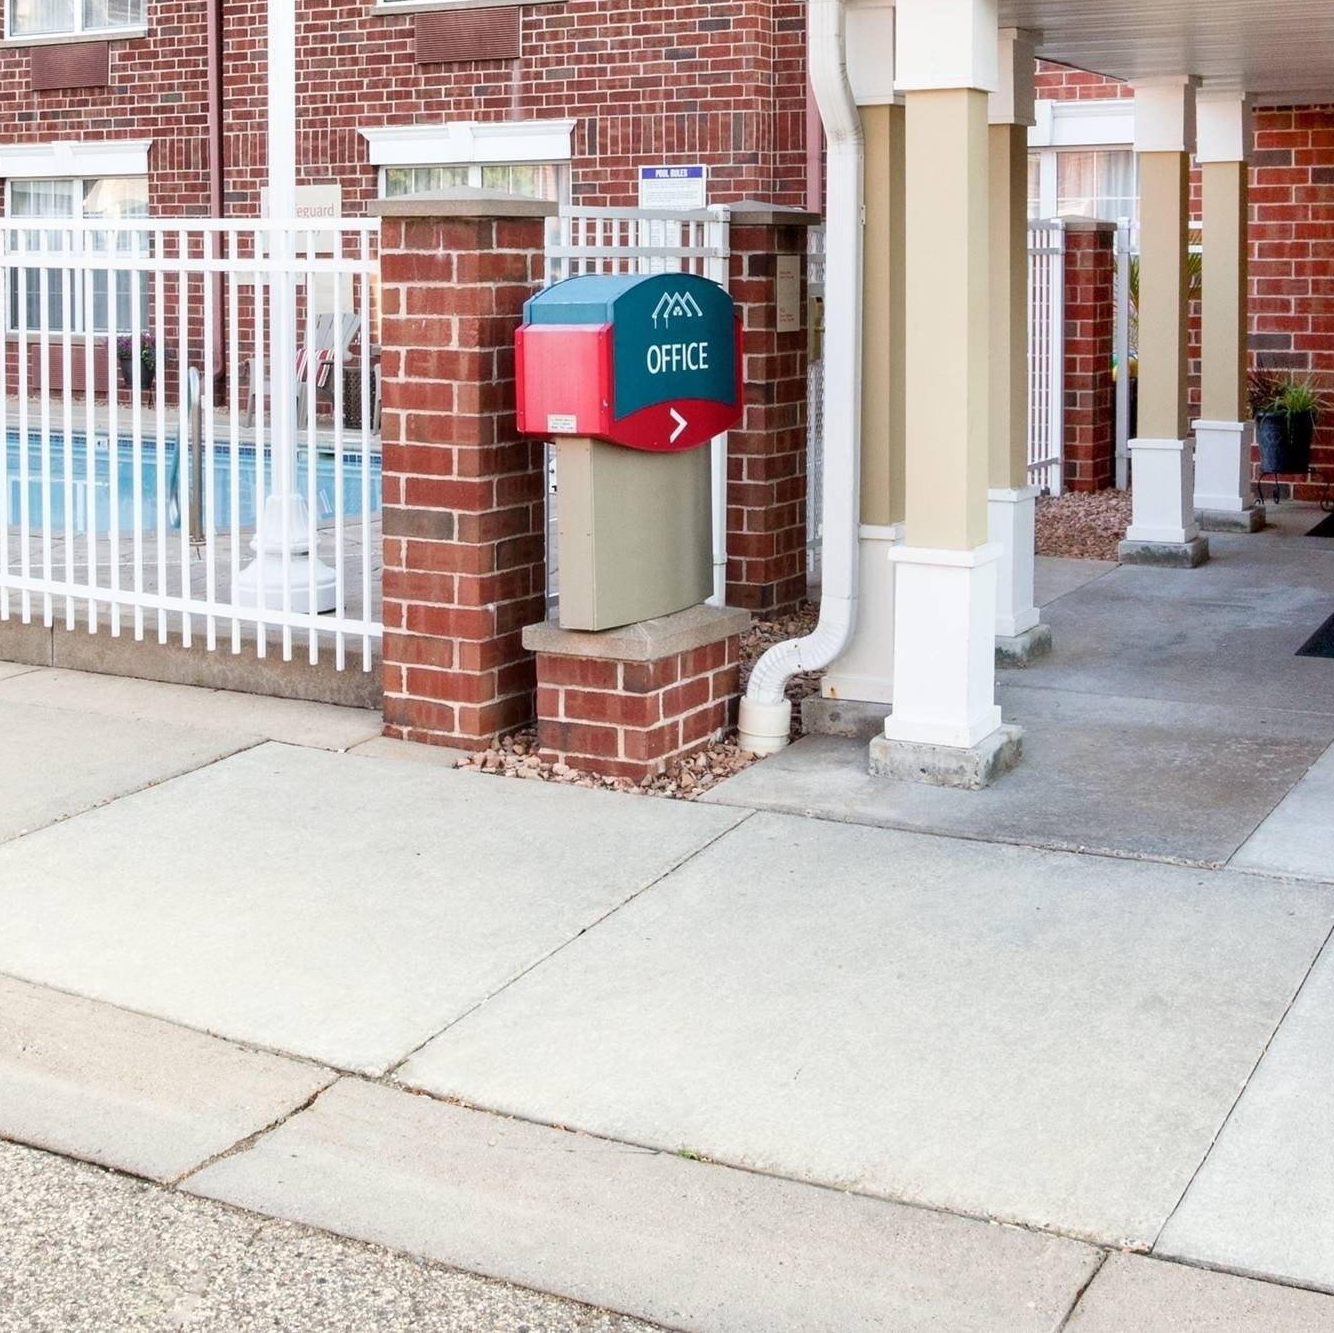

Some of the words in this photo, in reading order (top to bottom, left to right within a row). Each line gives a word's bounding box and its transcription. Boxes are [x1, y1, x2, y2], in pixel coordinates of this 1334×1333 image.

[655, 169, 669, 178] POOL
[670, 168, 688, 177] RULES
[294, 202, 334, 218] eguard
[646, 342, 709, 374] OFFICE
